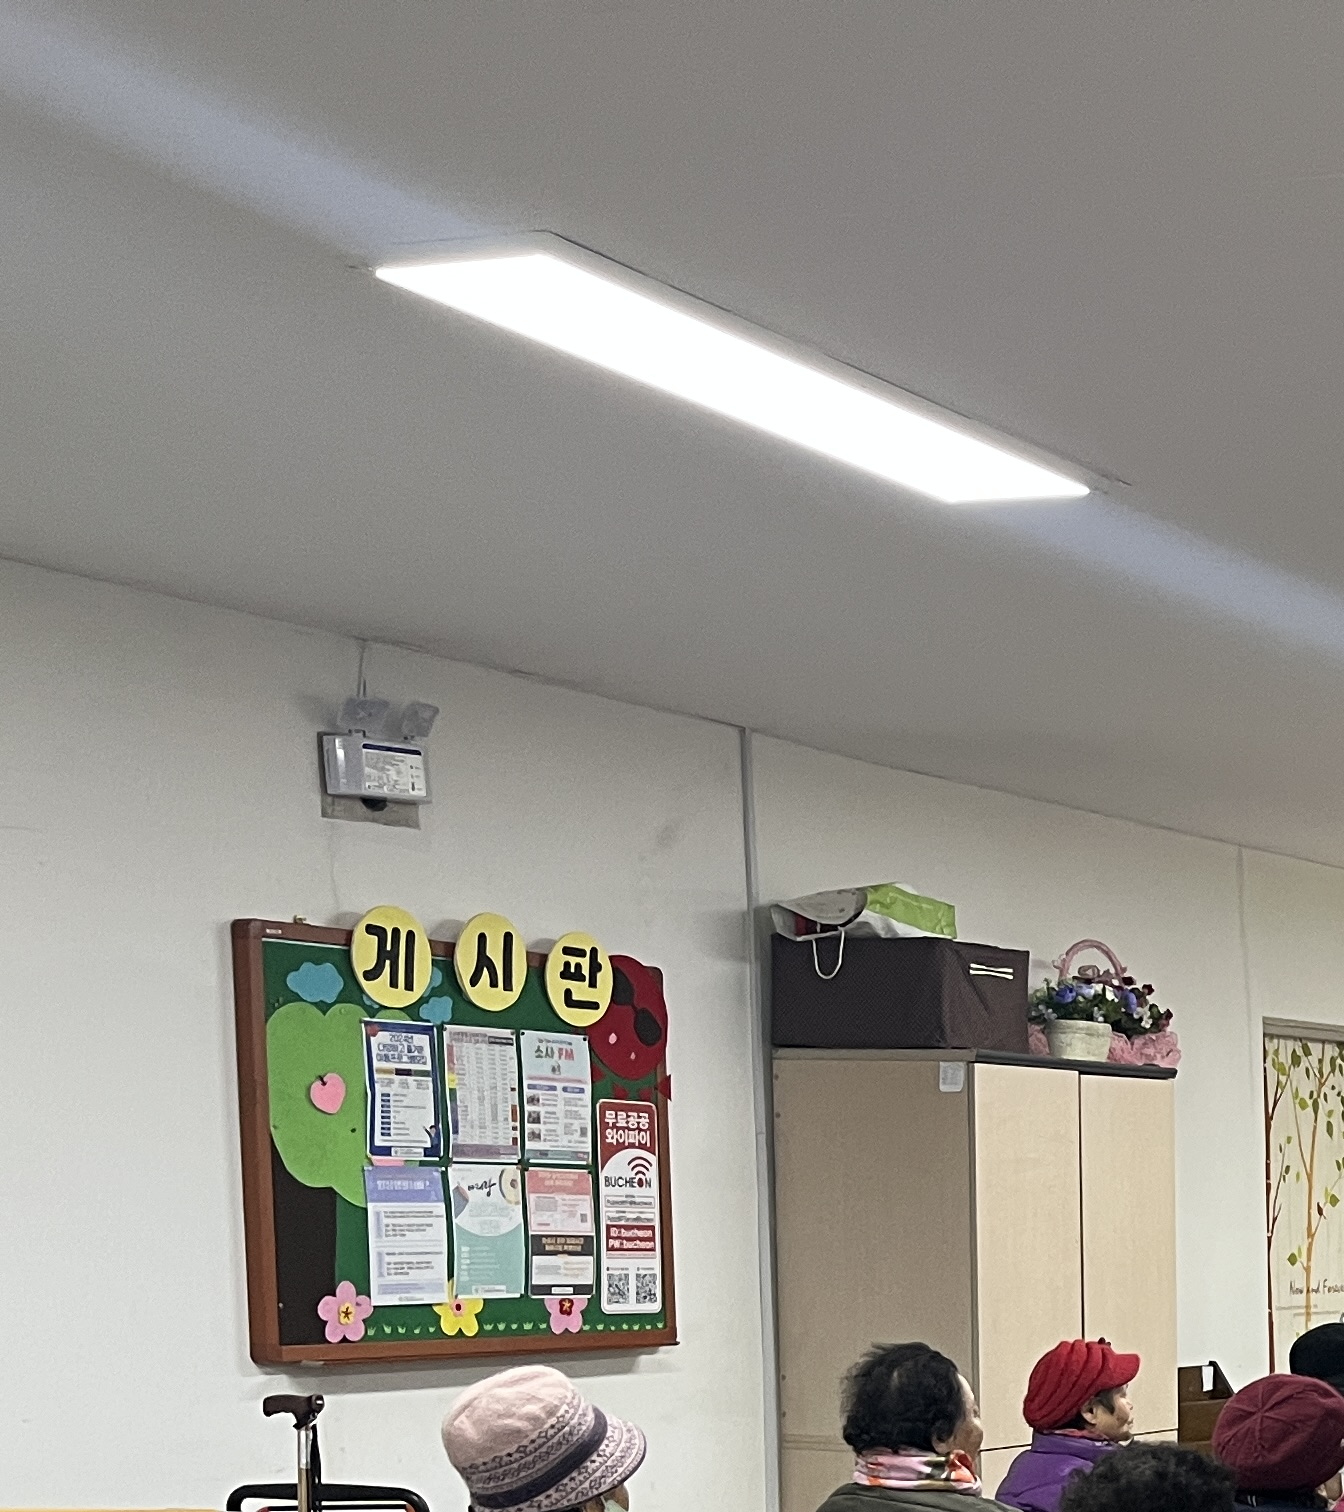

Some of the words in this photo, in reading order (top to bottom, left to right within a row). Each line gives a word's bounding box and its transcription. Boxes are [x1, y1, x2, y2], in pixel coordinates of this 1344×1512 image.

[363, 923, 602, 1011] 게시판
[535, 1045, 554, 1059] 소사
[558, 1047, 575, 1061] FM
[605, 1110, 650, 1130] 무료공공
[605, 1128, 651, 1148] 와이파이
[604, 1175, 652, 1188] BUCHEON
